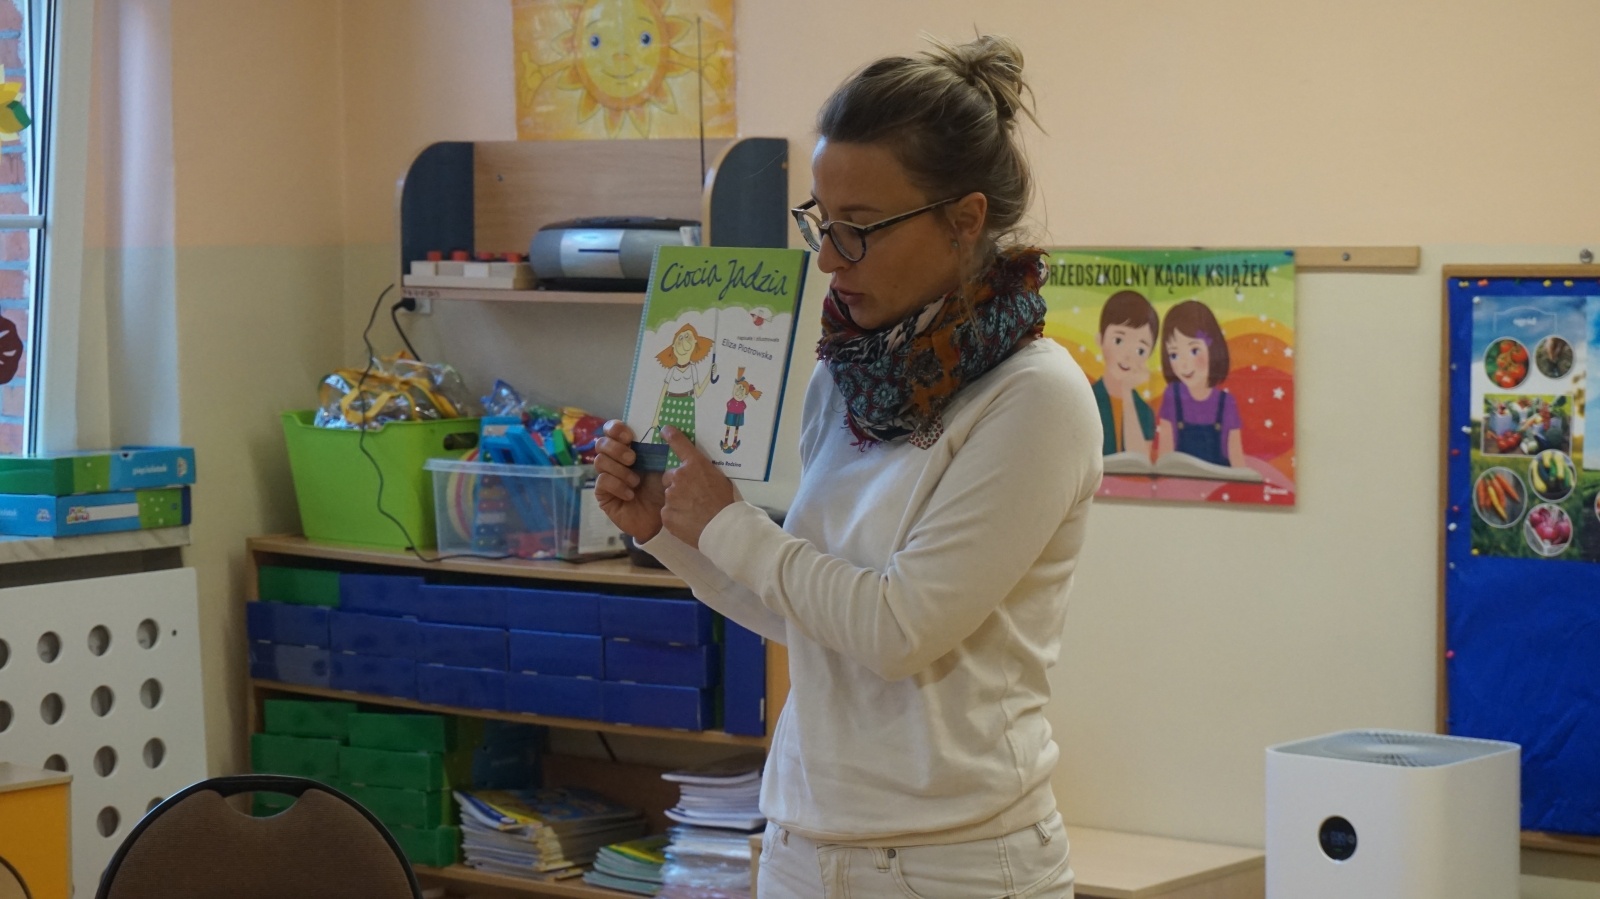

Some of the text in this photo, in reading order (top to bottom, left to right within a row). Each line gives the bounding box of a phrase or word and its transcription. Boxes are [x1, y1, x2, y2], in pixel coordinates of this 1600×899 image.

[660, 259, 788, 300] Ciocia Jadzia
[1050, 260, 1269, 294] RZEDSZKOLNY KĄCIK KSIĄŻEK
[721, 338, 773, 361] Eliza Piotrowska
